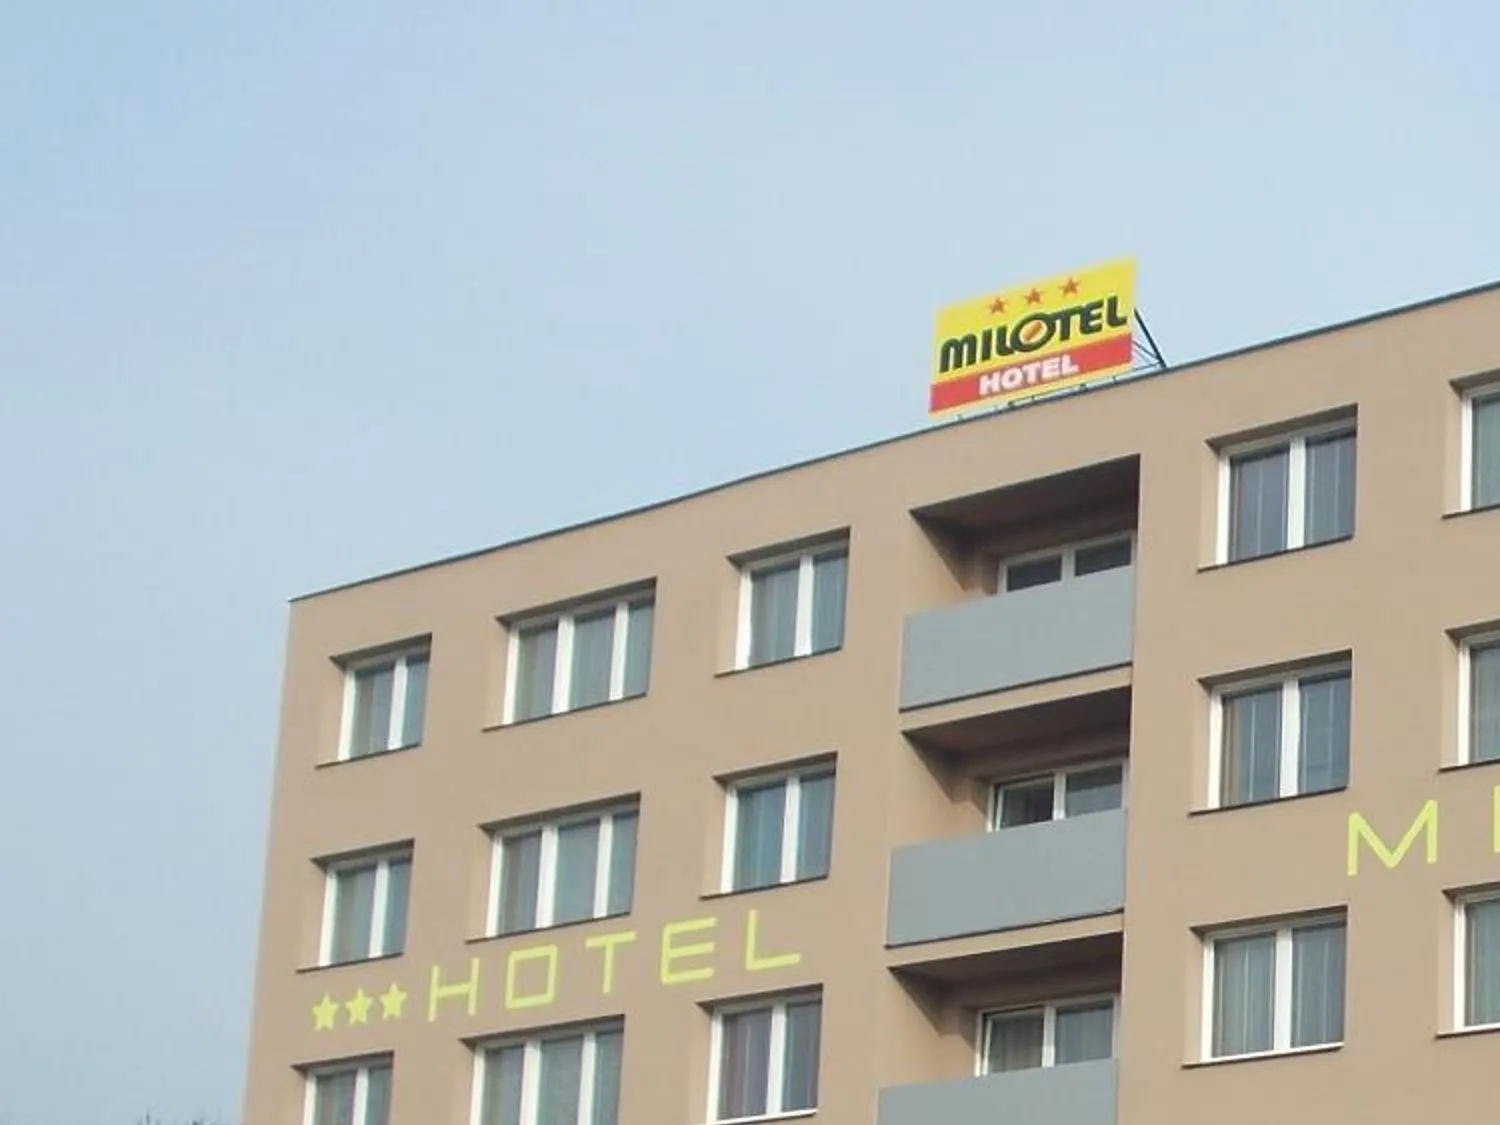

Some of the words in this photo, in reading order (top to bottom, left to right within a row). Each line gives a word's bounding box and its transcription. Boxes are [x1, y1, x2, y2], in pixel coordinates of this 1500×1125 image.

[938, 295, 1129, 374] MILOTEL
[978, 353, 1080, 396] HOTEL
[427, 908, 803, 1023] HOTEL
